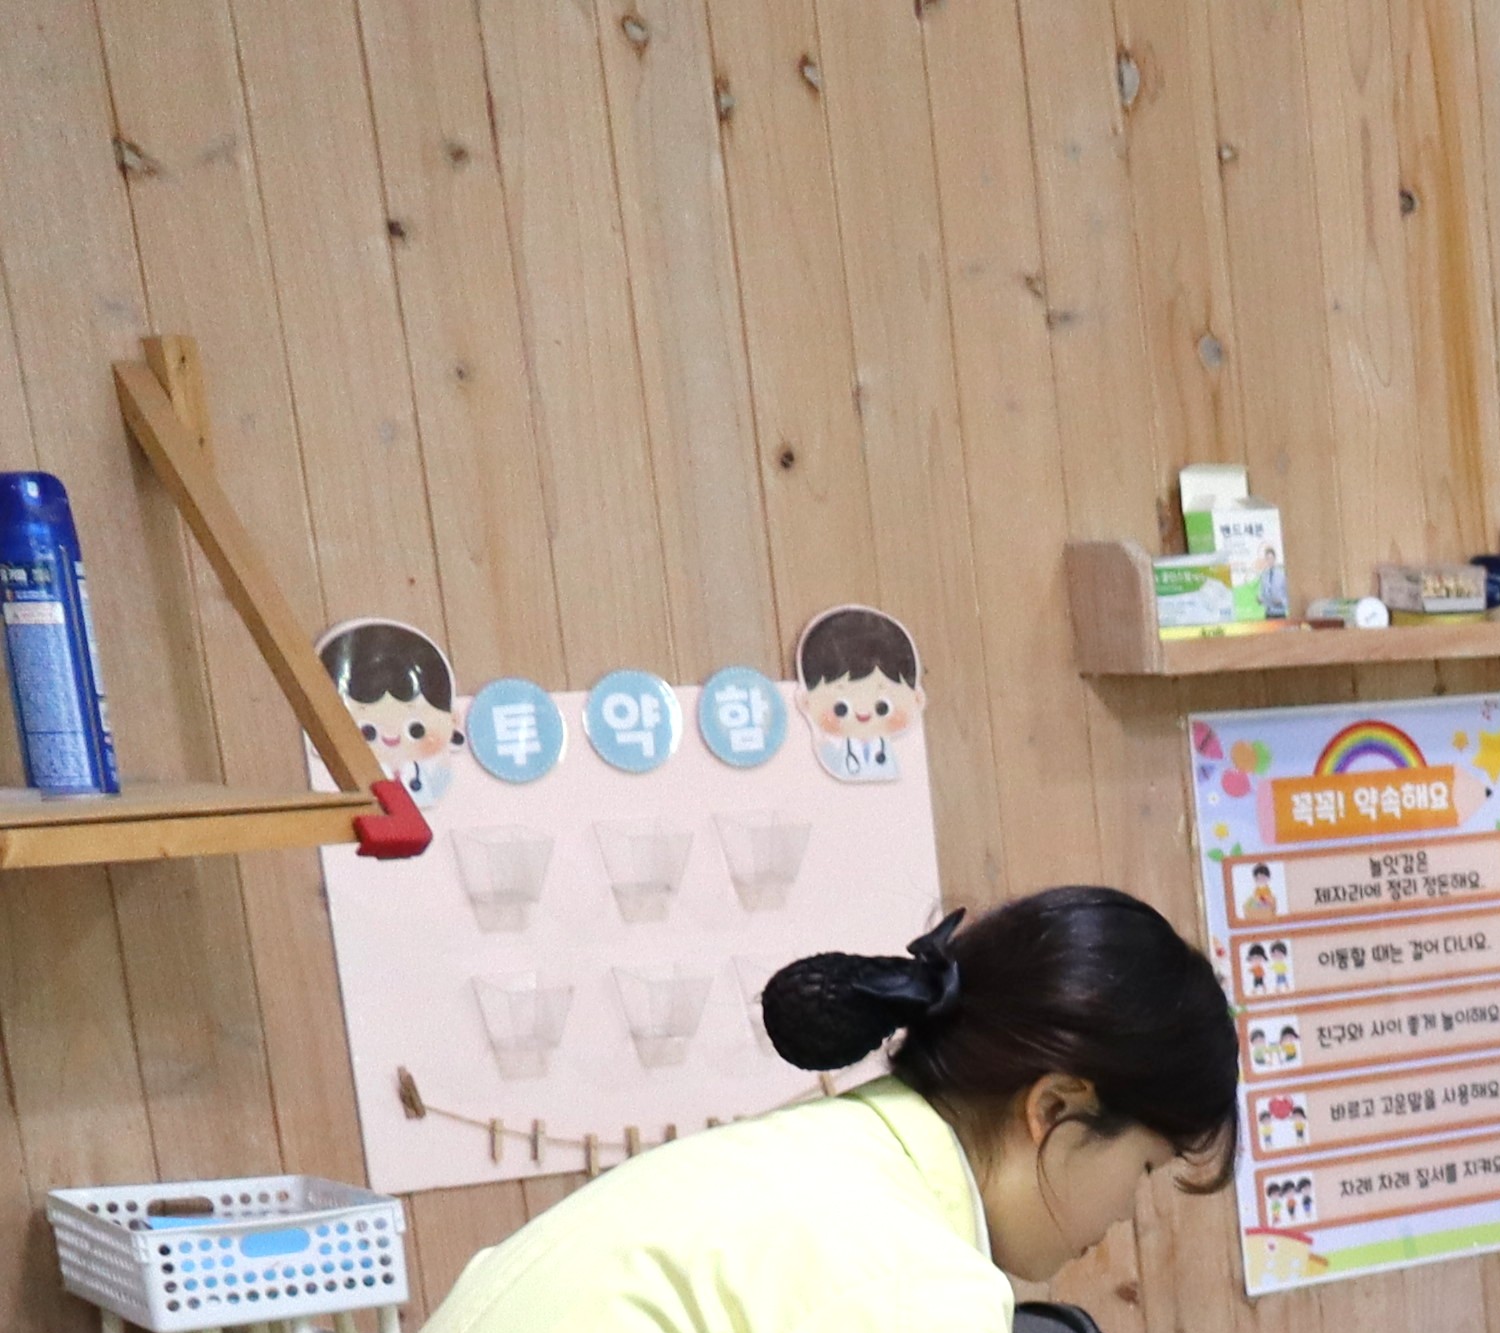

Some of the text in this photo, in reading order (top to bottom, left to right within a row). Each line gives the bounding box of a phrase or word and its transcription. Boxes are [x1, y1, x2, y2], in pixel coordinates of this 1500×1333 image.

[490, 686, 767, 767] 투약함
[1353, 781, 1450, 821] 약속해요
[1314, 881, 1382, 906] 제자리에
[1387, 878, 1417, 901] 정리
[1318, 943, 1366, 970] 이동할
[1372, 941, 1404, 965] 때는
[1316, 1021, 1364, 1049] 친구와
[1330, 1098, 1376, 1123] 바르고
